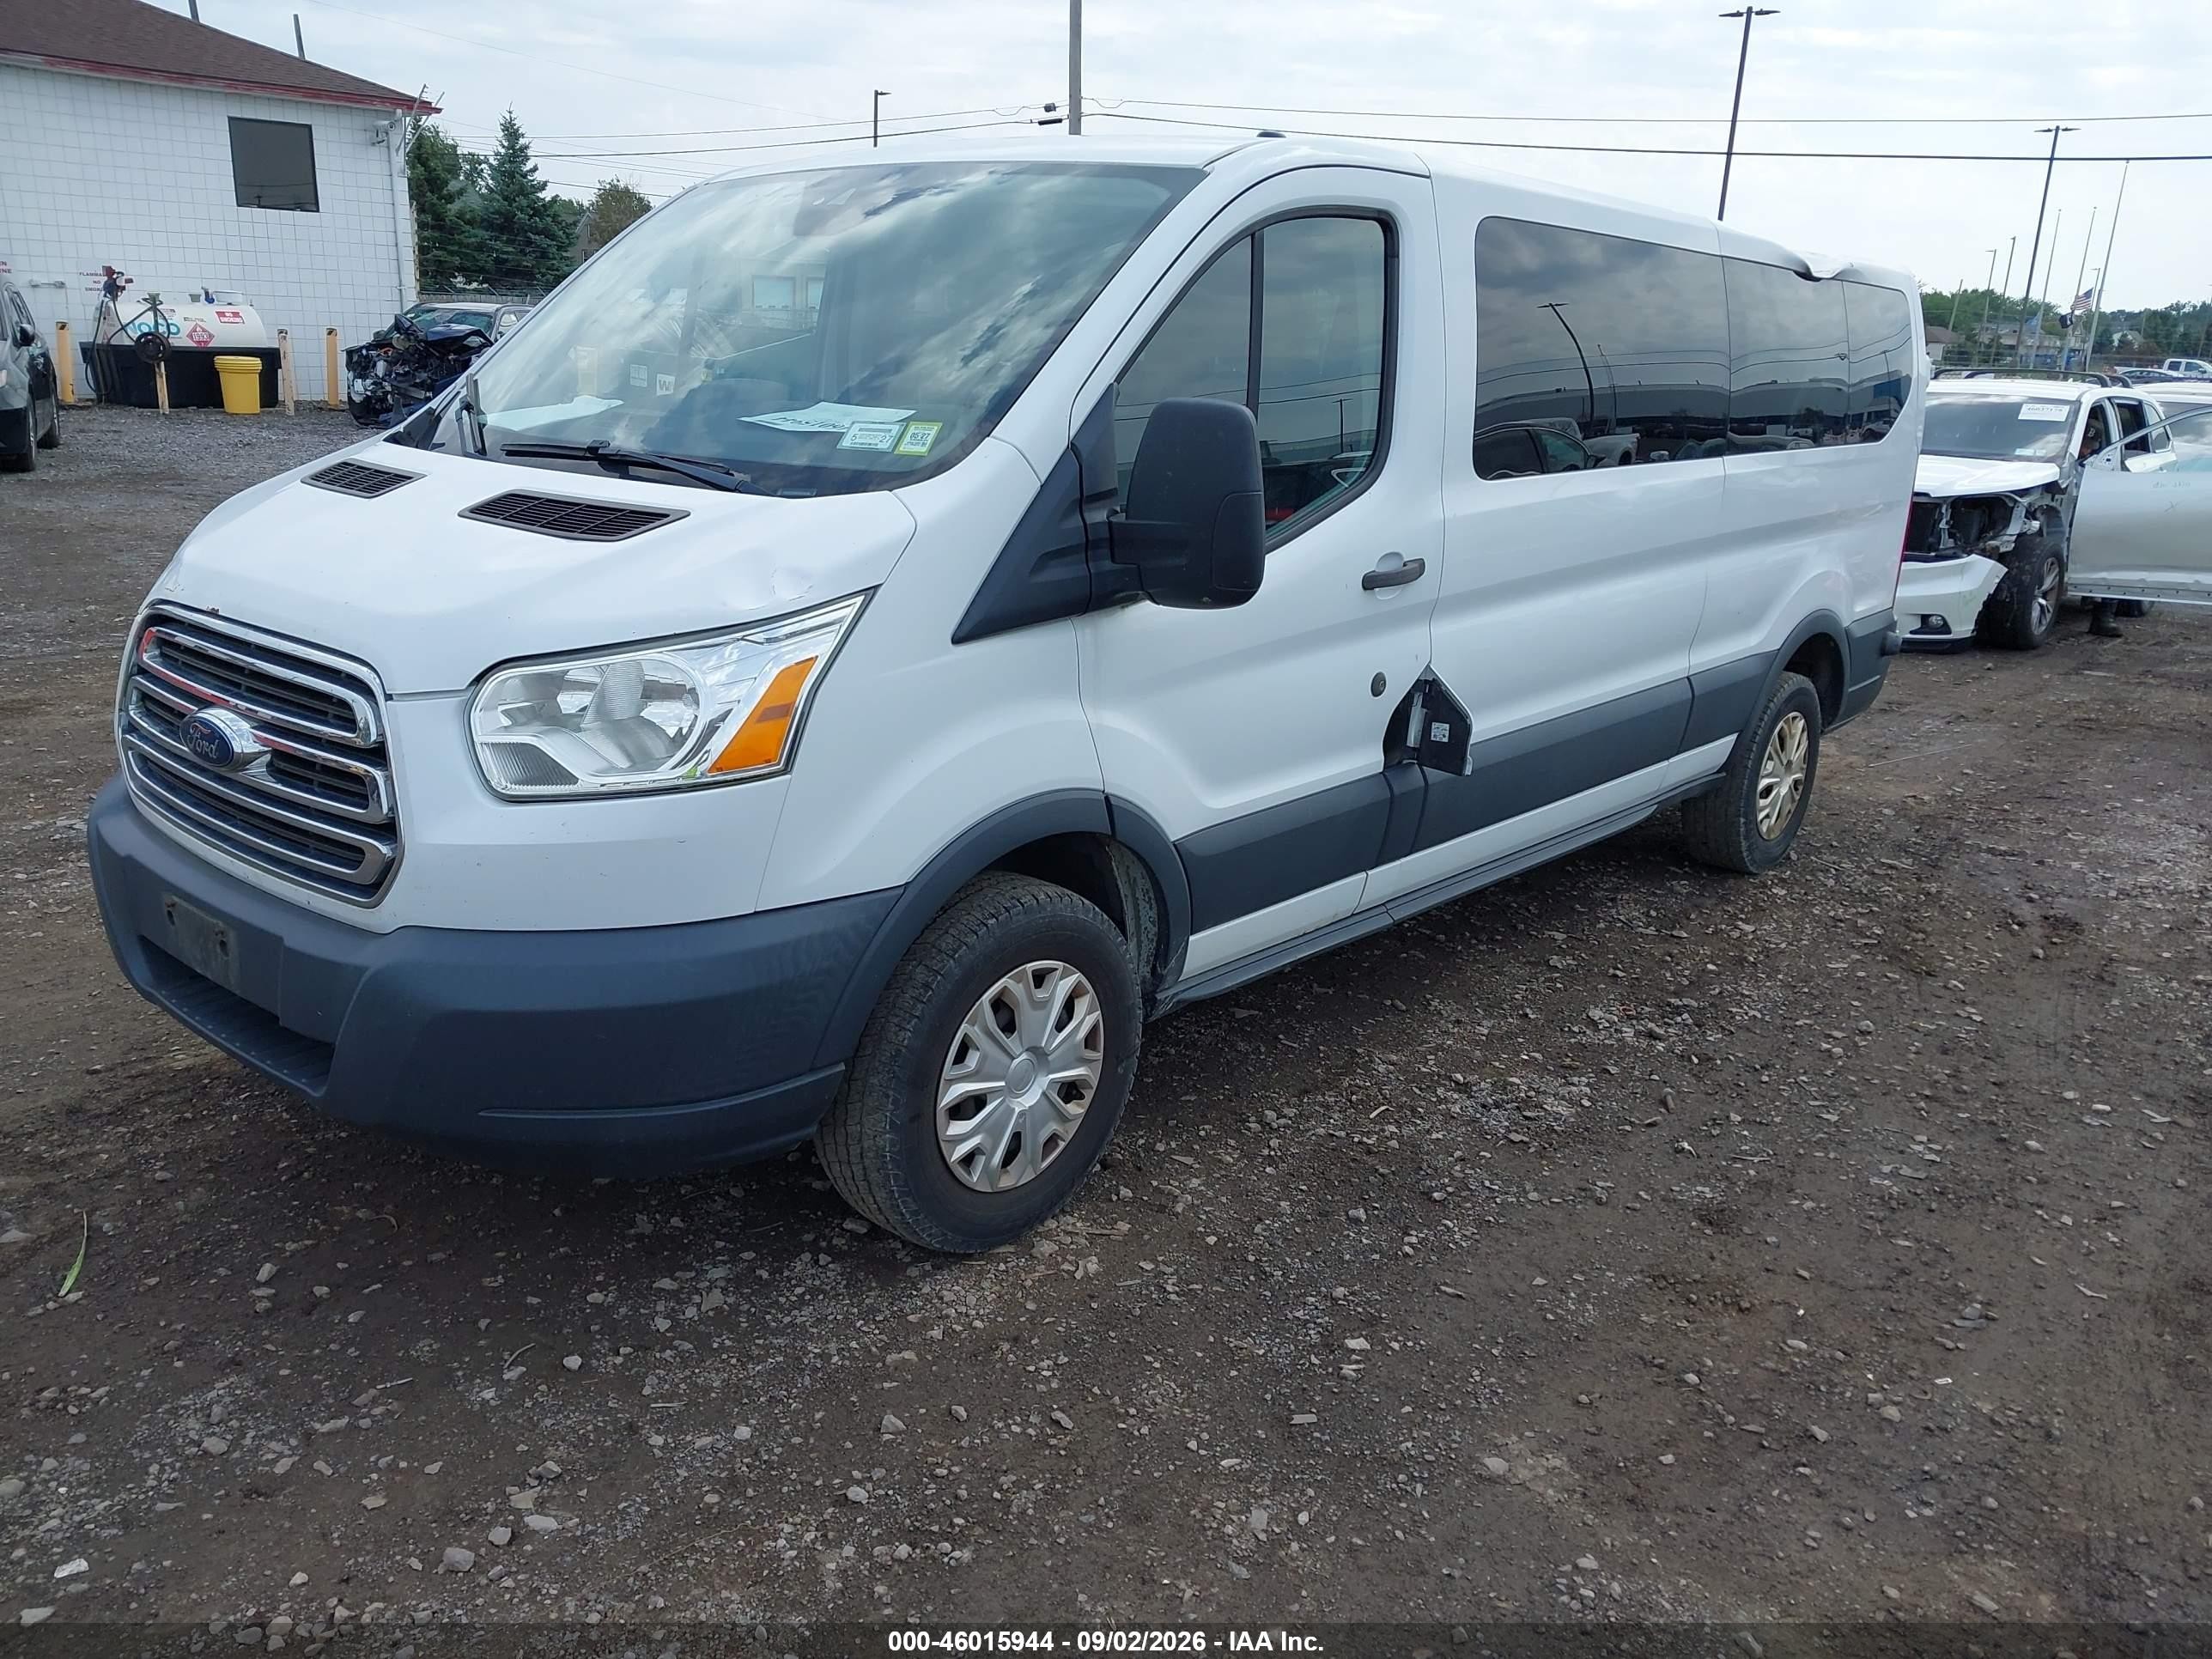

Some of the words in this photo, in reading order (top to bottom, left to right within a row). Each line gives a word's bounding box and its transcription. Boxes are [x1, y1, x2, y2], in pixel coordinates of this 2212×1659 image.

[193, 332, 208, 341] 1993
[879, 434, 893, 443] 27
[187, 722, 220, 759] Ford
